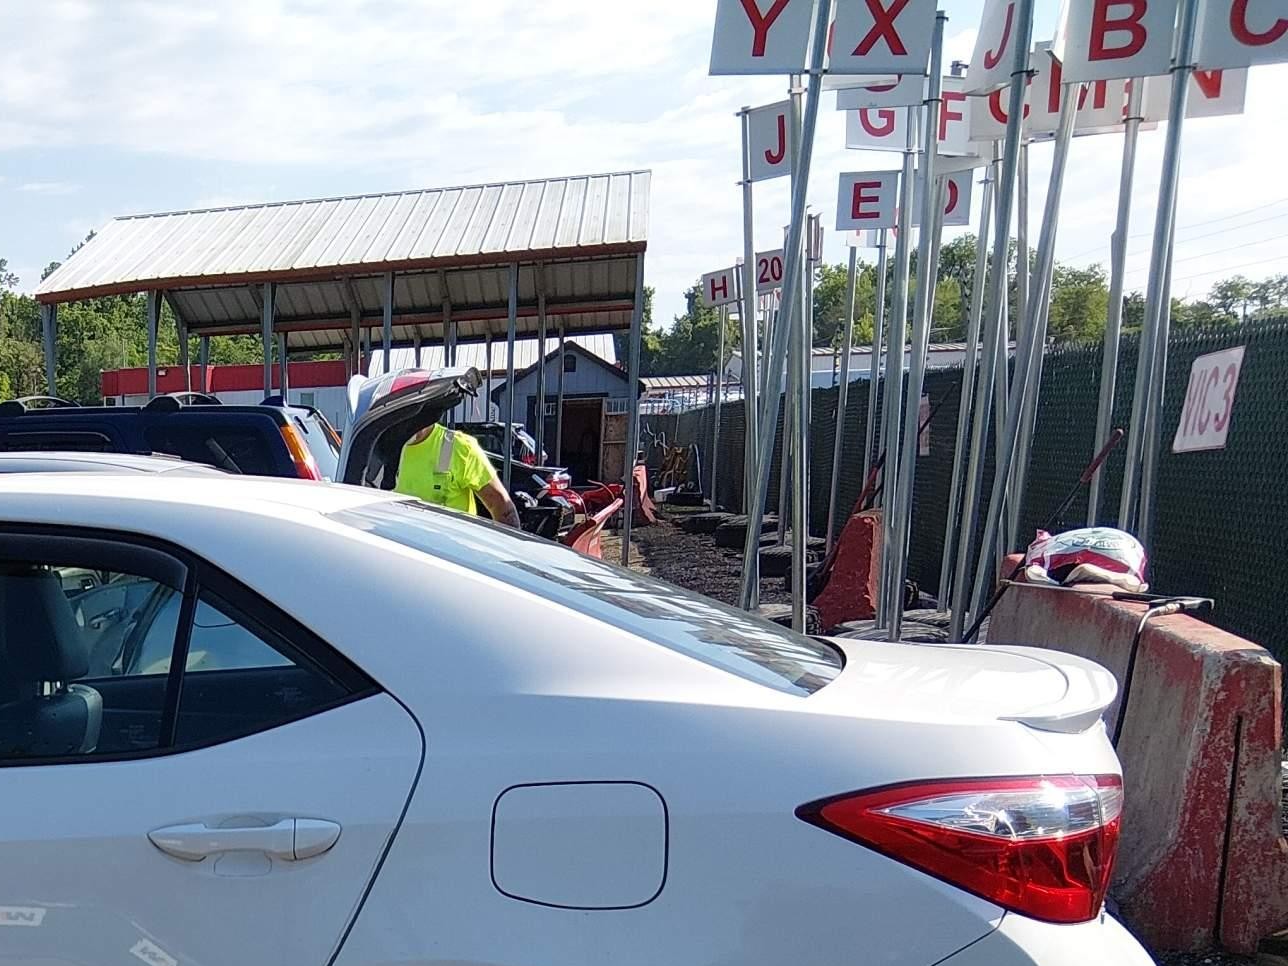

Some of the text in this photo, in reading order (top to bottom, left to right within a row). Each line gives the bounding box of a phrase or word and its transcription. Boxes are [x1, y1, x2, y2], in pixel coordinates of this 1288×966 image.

[739, 0, 789, 57] Y
[851, 0, 909, 56] X
[1088, 0, 1147, 62] B
[1230, 0, 1288, 46] C
[764, 114, 786, 165] J
[938, 90, 968, 141] F
[851, 181, 882, 220] E
[711, 275, 729, 301] H
[757, 256, 783, 284] 20
